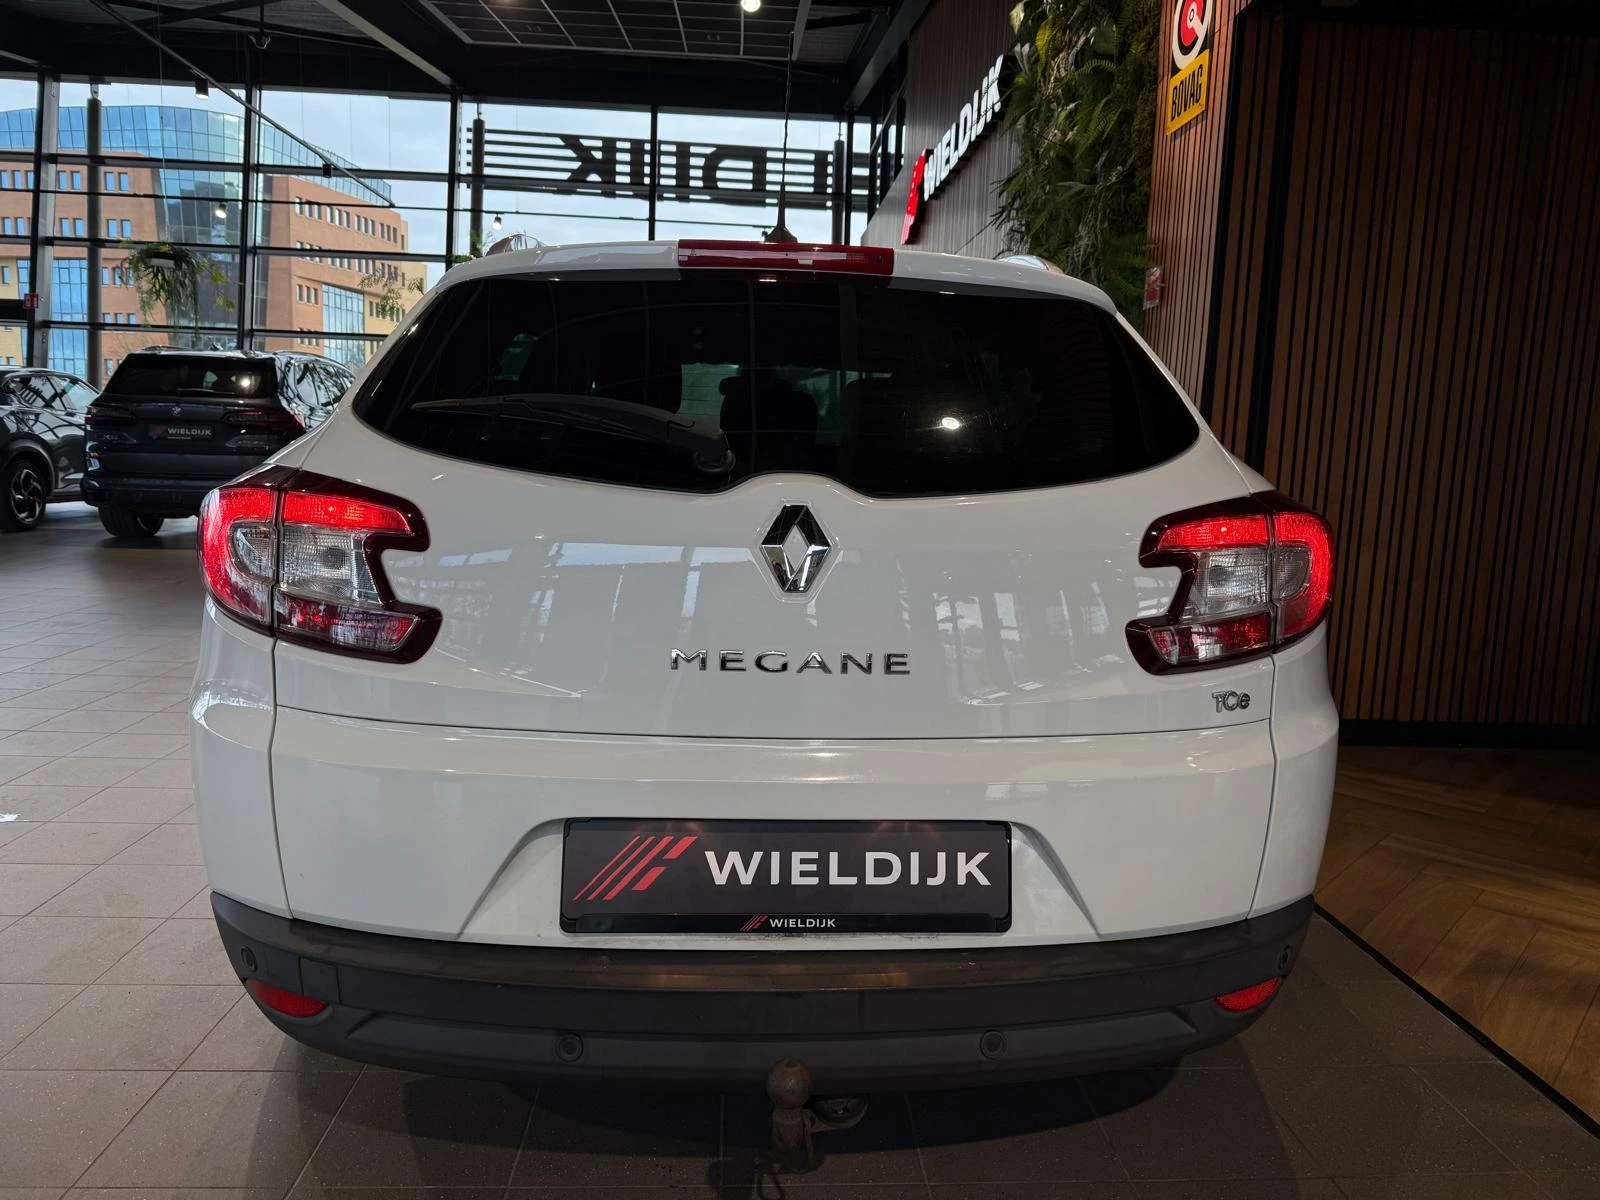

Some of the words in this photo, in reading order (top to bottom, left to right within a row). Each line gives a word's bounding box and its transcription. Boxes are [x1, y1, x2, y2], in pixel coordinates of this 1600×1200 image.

[1171, 64, 1203, 121] BOVAG
[924, 54, 1002, 201] WIELDIJK
[671, 648, 910, 674] MEGANE
[1212, 690, 1250, 712] TCe
[704, 851, 992, 886] WIELDIJK
[769, 918, 836, 928] WIELDIJK
